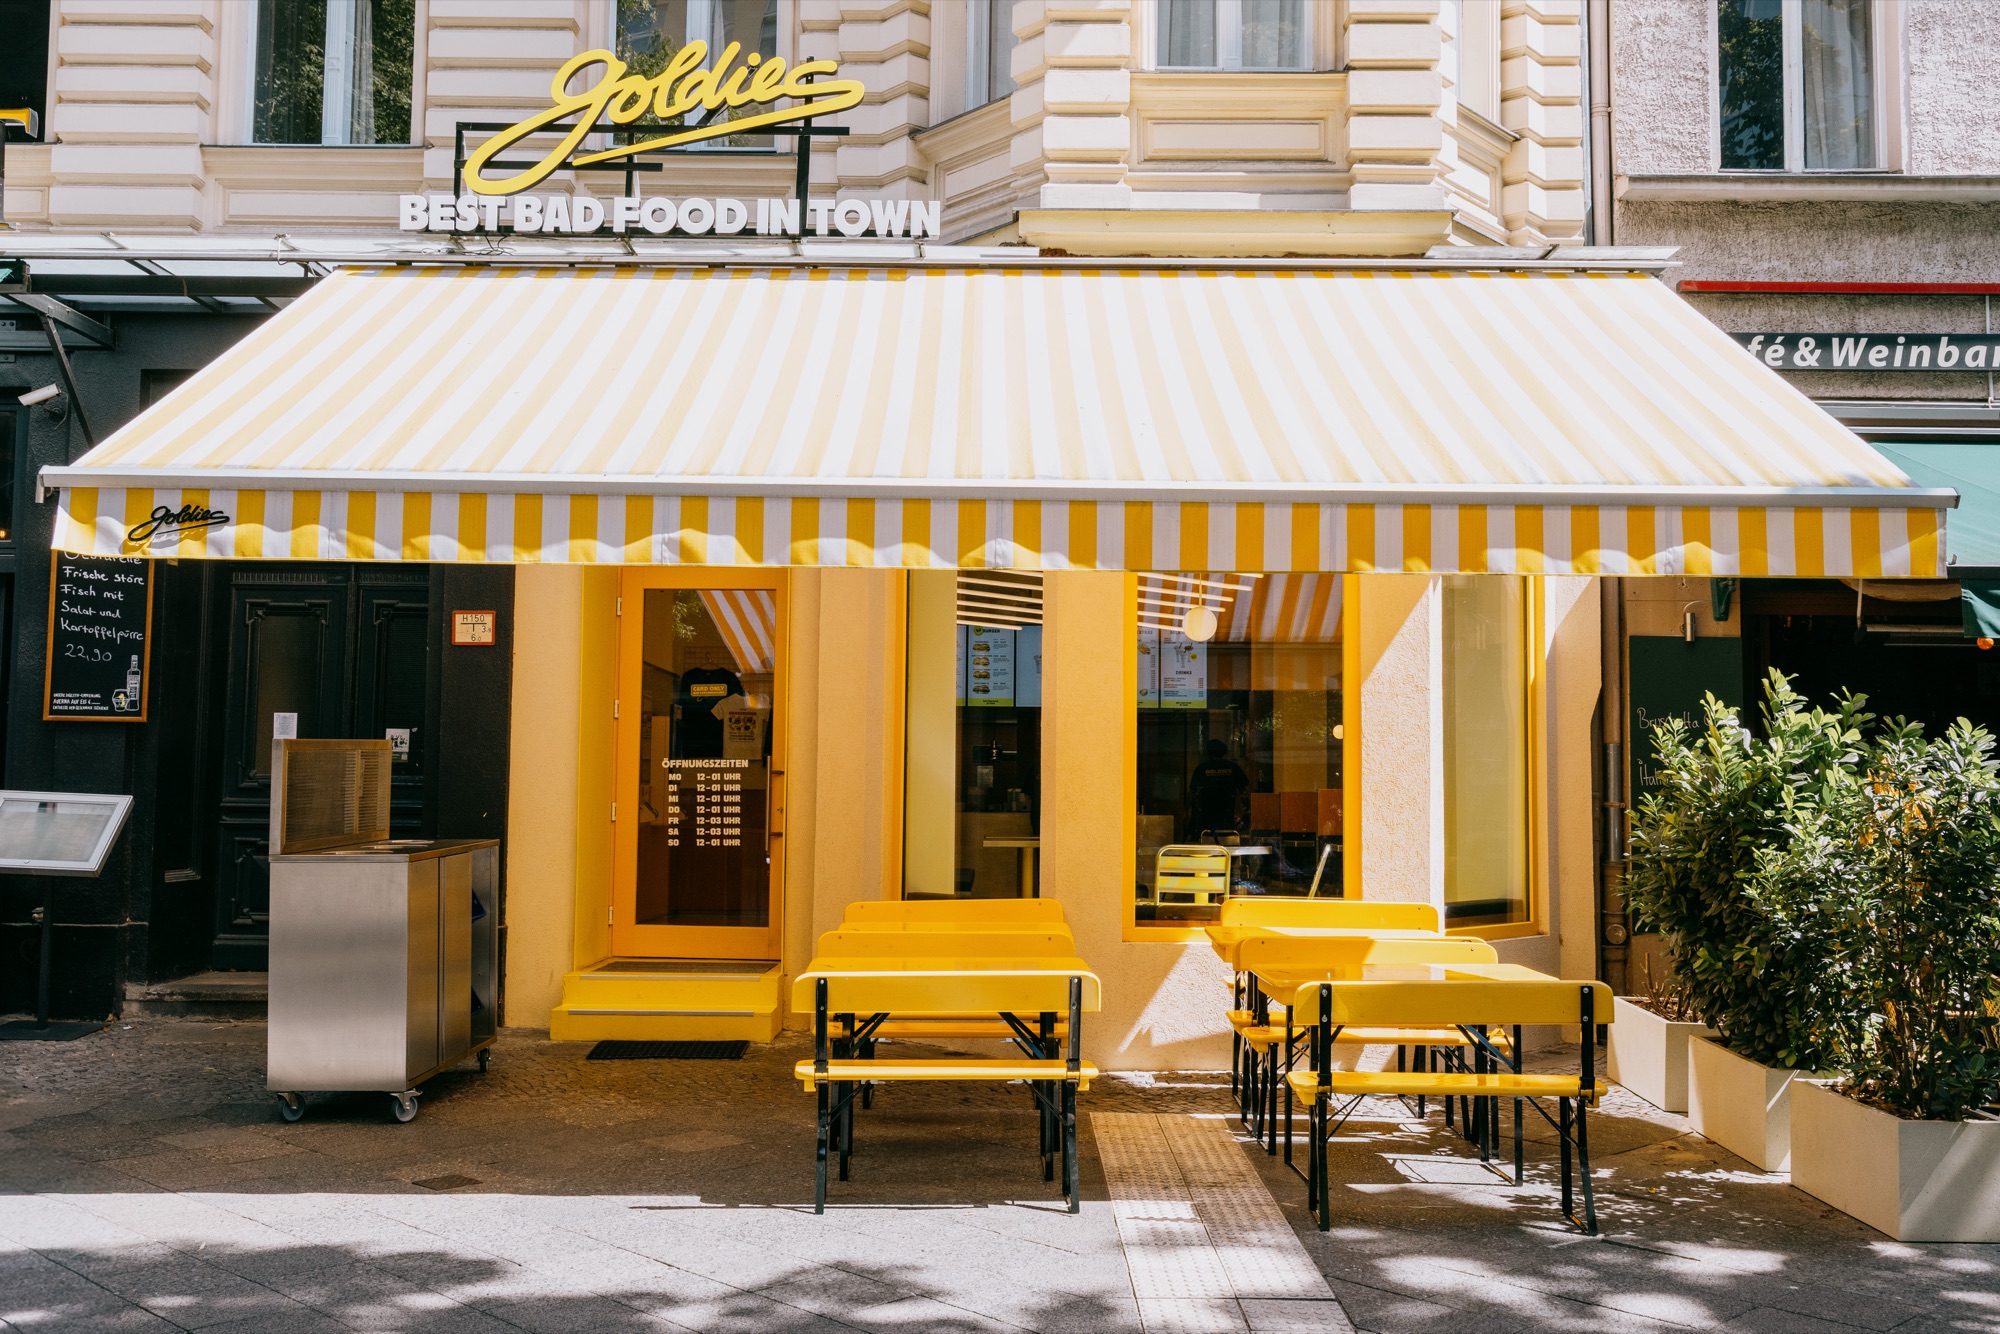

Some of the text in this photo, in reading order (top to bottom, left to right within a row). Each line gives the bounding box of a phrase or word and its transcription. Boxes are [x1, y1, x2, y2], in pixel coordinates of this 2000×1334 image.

[399, 194, 941, 238] BEST BAD FOOD IN TOWN
[1747, 335, 1785, 367] fé
[1793, 336, 1822, 367] &
[62, 566, 108, 581] Frische
[60, 584, 124, 601] Fisch mit
[61, 600, 121, 618] Salat und
[661, 758, 749, 768] ÖFFNUNGSZEITEN
[668, 773, 682, 781] MO
[723, 773, 741, 781] UHR
[668, 784, 678, 792] DI
[723, 784, 741, 792] UHR
[668, 795, 679, 803] MI
[723, 795, 741, 803] UHR
[668, 806, 680, 814] DO
[723, 806, 741, 814] UHR
[668, 817, 679, 825] FR
[723, 817, 741, 825] UHR
[668, 828, 679, 836] SA
[723, 828, 741, 836] UHR
[667, 839, 680, 847] SO
[723, 839, 741, 847] UHR
